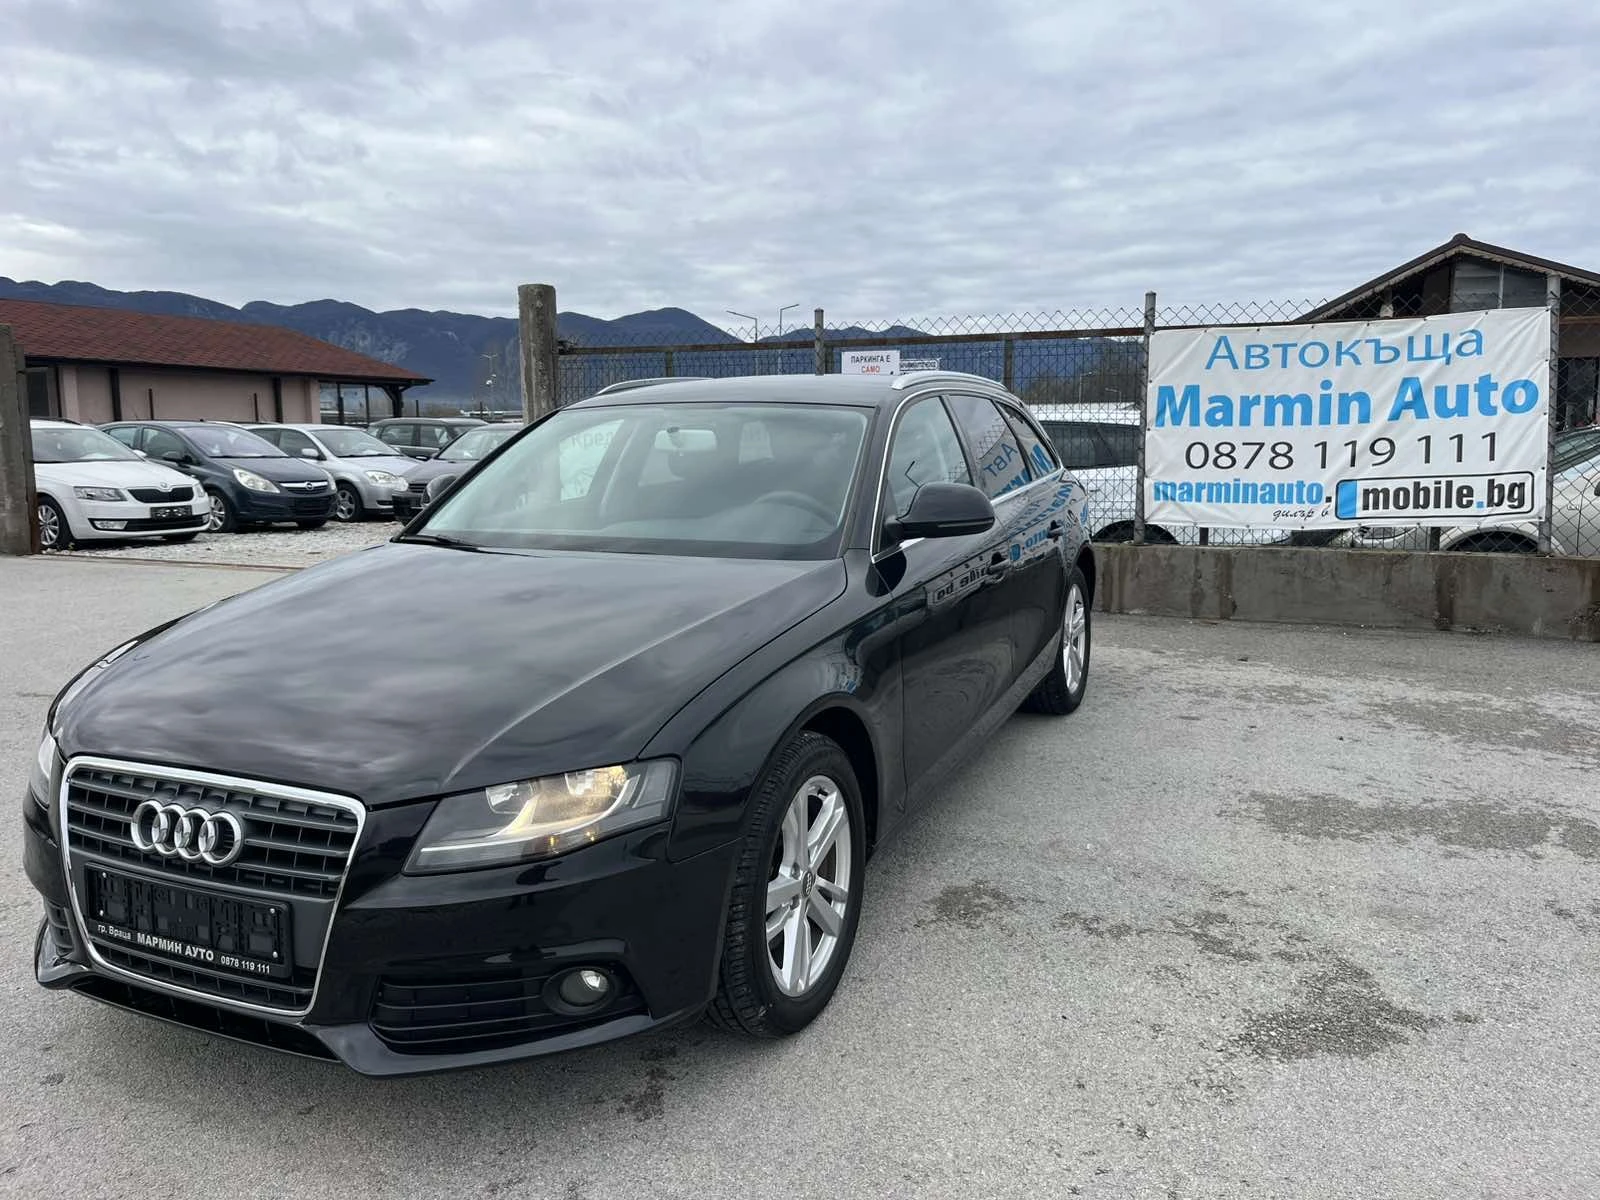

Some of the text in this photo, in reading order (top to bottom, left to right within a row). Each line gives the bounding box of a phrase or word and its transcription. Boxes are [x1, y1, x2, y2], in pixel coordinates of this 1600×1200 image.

[850, 355, 884, 364] ПАРКИНГА
[1205, 328, 1484, 370] Автокъща
[861, 365, 880, 374] САМО
[1154, 373, 1540, 428] Marmin Auto
[1184, 432, 1497, 470] 0878 119 111
[1361, 478, 1526, 511] mobile.bg
[97, 924, 270, 975] гр. Враца МАРМИН АУТО 0878 119 111
